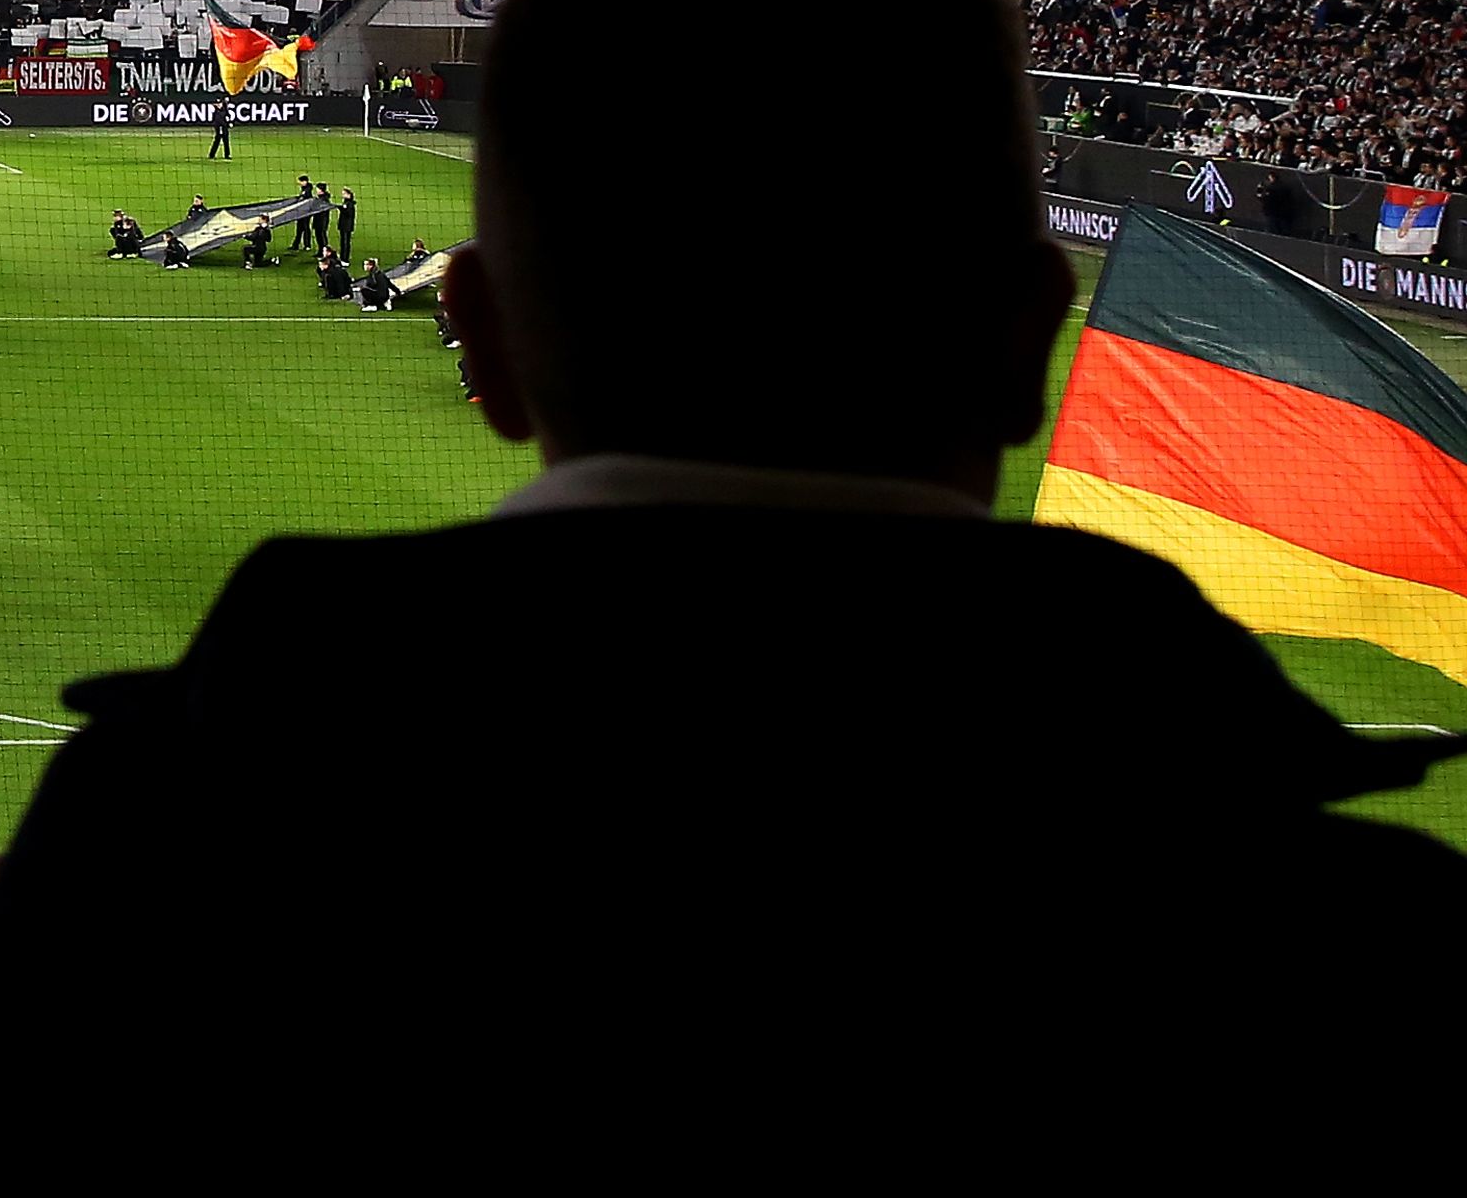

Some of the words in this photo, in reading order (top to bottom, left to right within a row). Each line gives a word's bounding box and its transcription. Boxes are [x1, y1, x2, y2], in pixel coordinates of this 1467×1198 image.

[19, 61, 106, 90] SELTERS/Ts.
[93, 104, 129, 122] DIE
[1342, 257, 1378, 292] DIE
[1395, 268, 1467, 310] MANN
